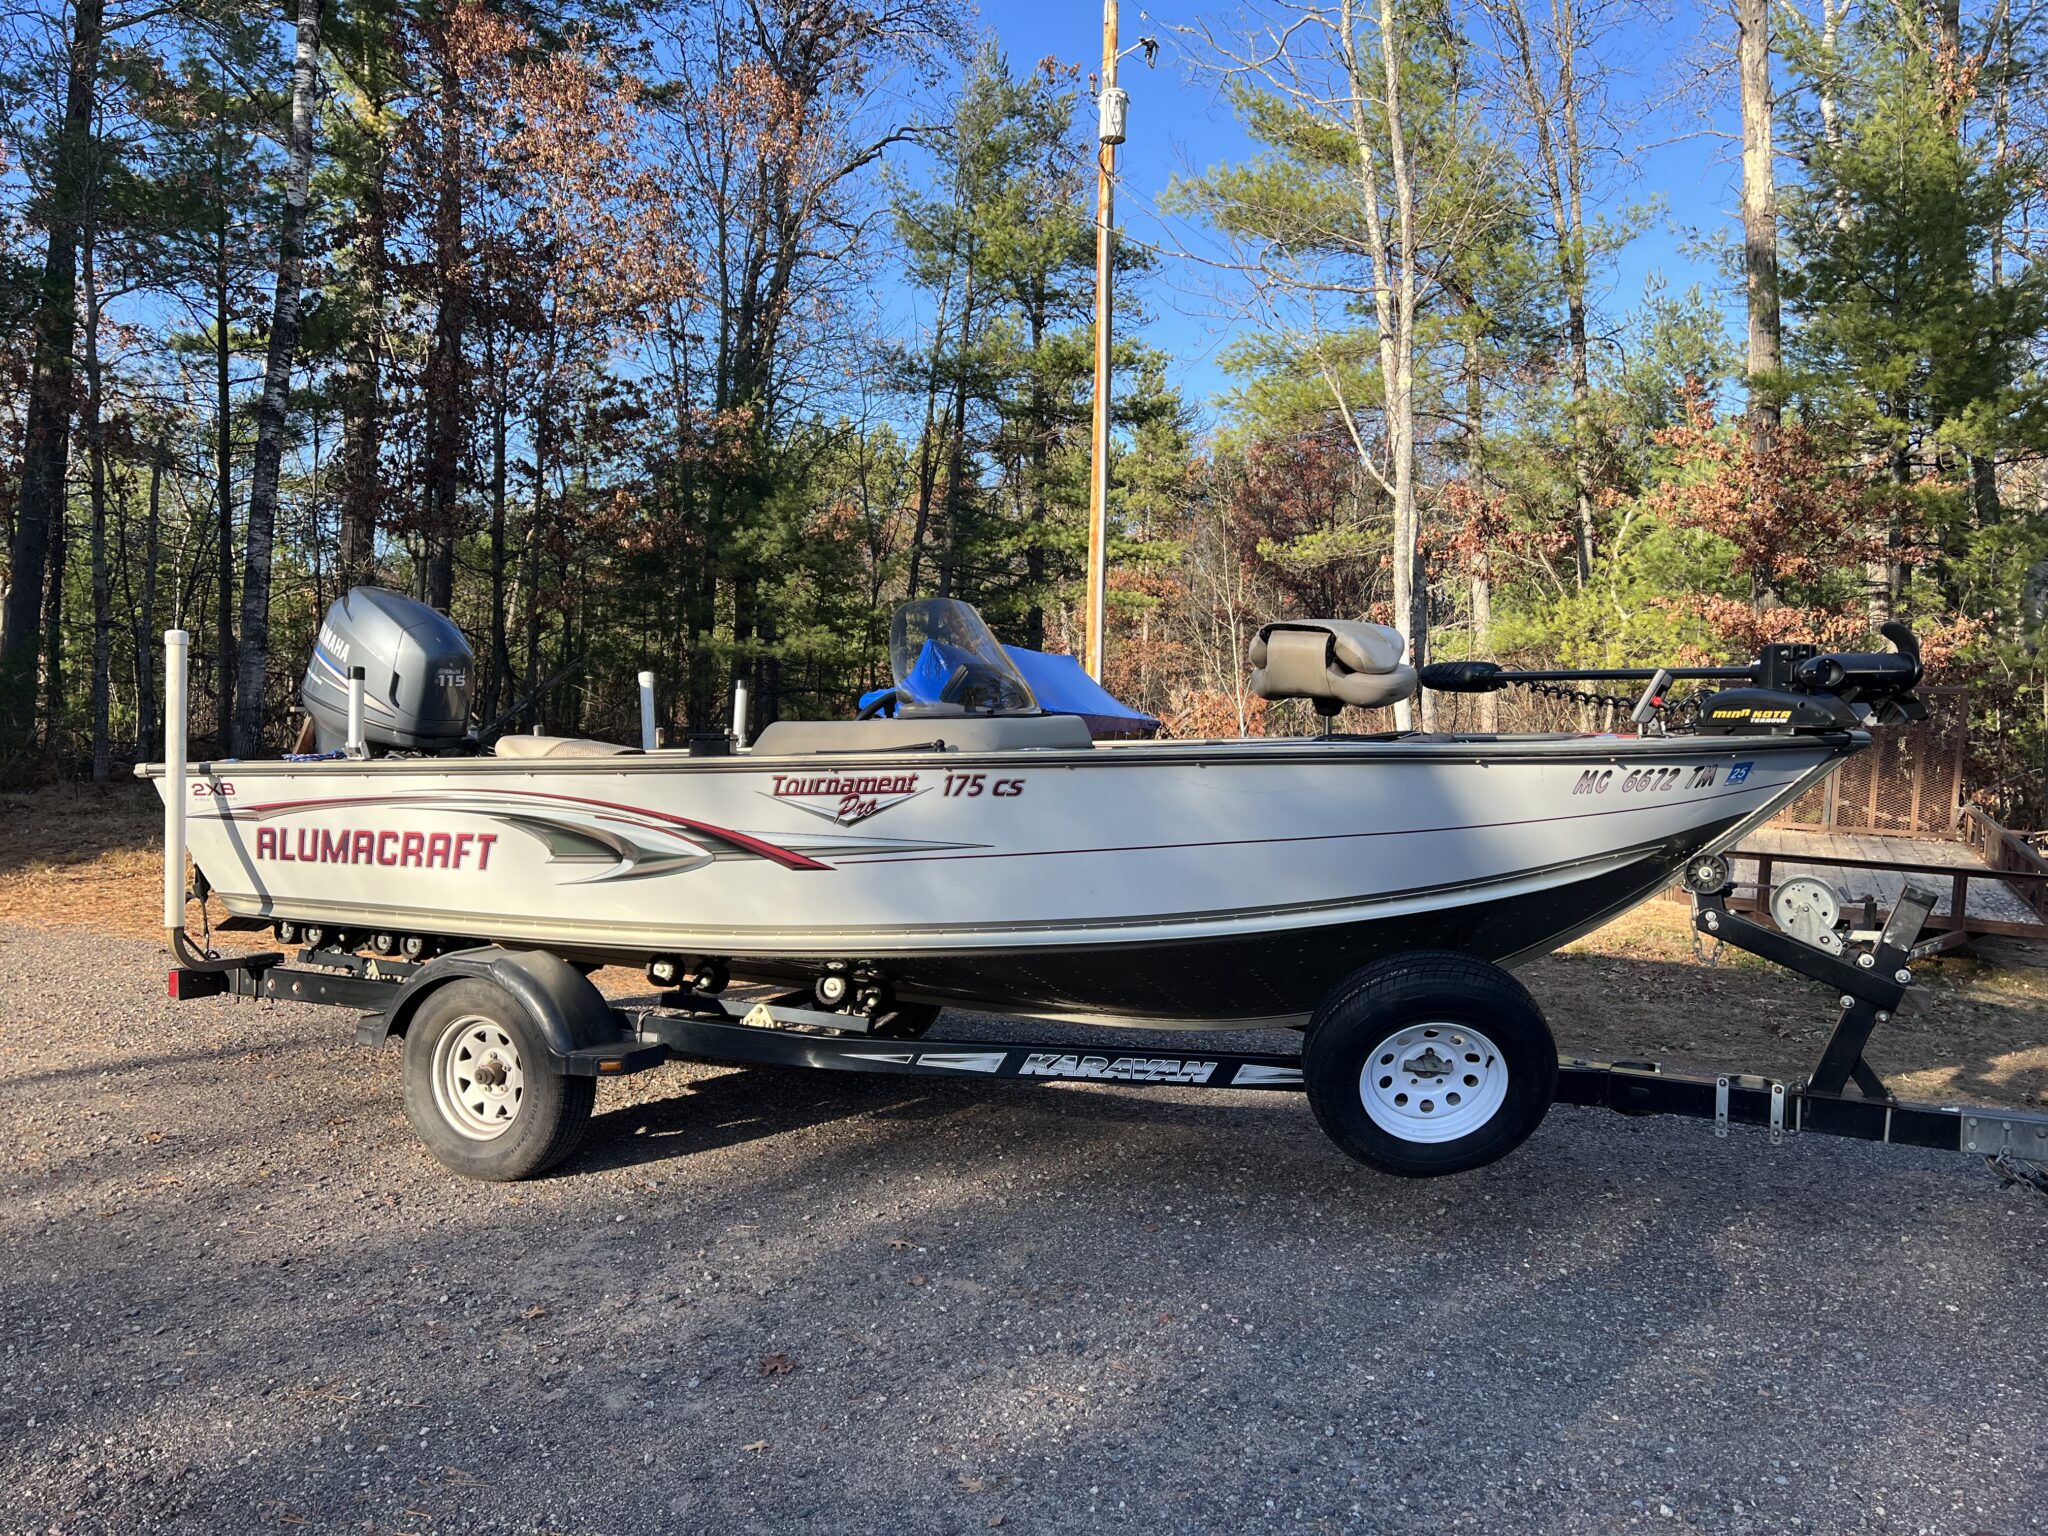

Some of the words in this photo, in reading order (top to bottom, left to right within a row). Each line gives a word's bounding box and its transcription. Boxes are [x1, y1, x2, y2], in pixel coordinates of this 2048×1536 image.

[318, 621, 351, 663] AMAHA
[437, 674, 466, 687] 115
[1752, 710, 1793, 719] KOTA
[771, 772, 919, 797] Tournament
[942, 773, 987, 798] 175
[1572, 769, 1612, 795] MC
[1621, 767, 1681, 793] 6672
[1684, 764, 1719, 789] TM
[1730, 767, 1748, 779] 25
[191, 782, 236, 796] 2XB
[833, 792, 880, 824] Pro
[256, 826, 499, 871] ALUMACRAFT
[1018, 1053, 1218, 1084] KARAVAN
